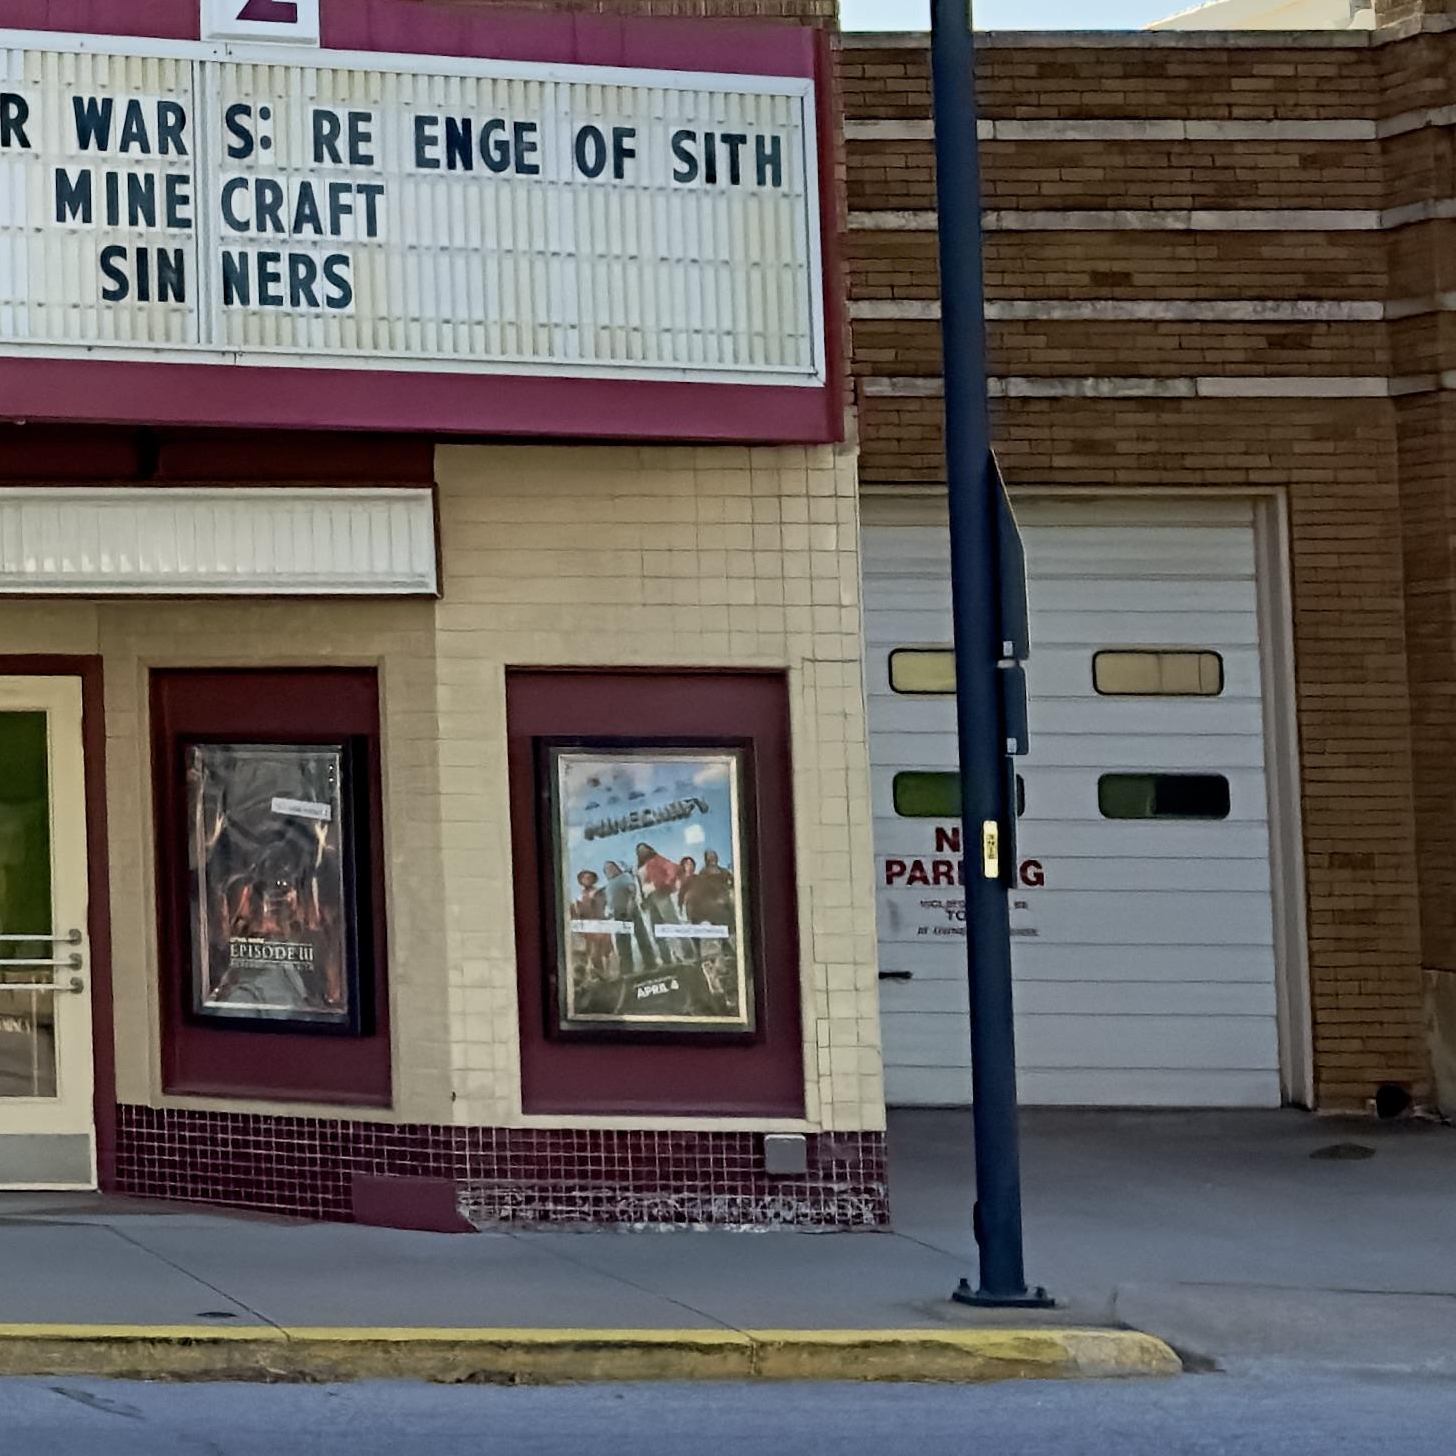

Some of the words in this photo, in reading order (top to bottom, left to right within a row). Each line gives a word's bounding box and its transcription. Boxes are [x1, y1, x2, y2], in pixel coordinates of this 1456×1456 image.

[575, 124, 637, 180] OF
[672, 129, 783, 187] SITH
[885, 859, 1045, 887] PARG
[230, 944, 295, 960] EPISODE
[637, 984, 669, 999] APRIL
